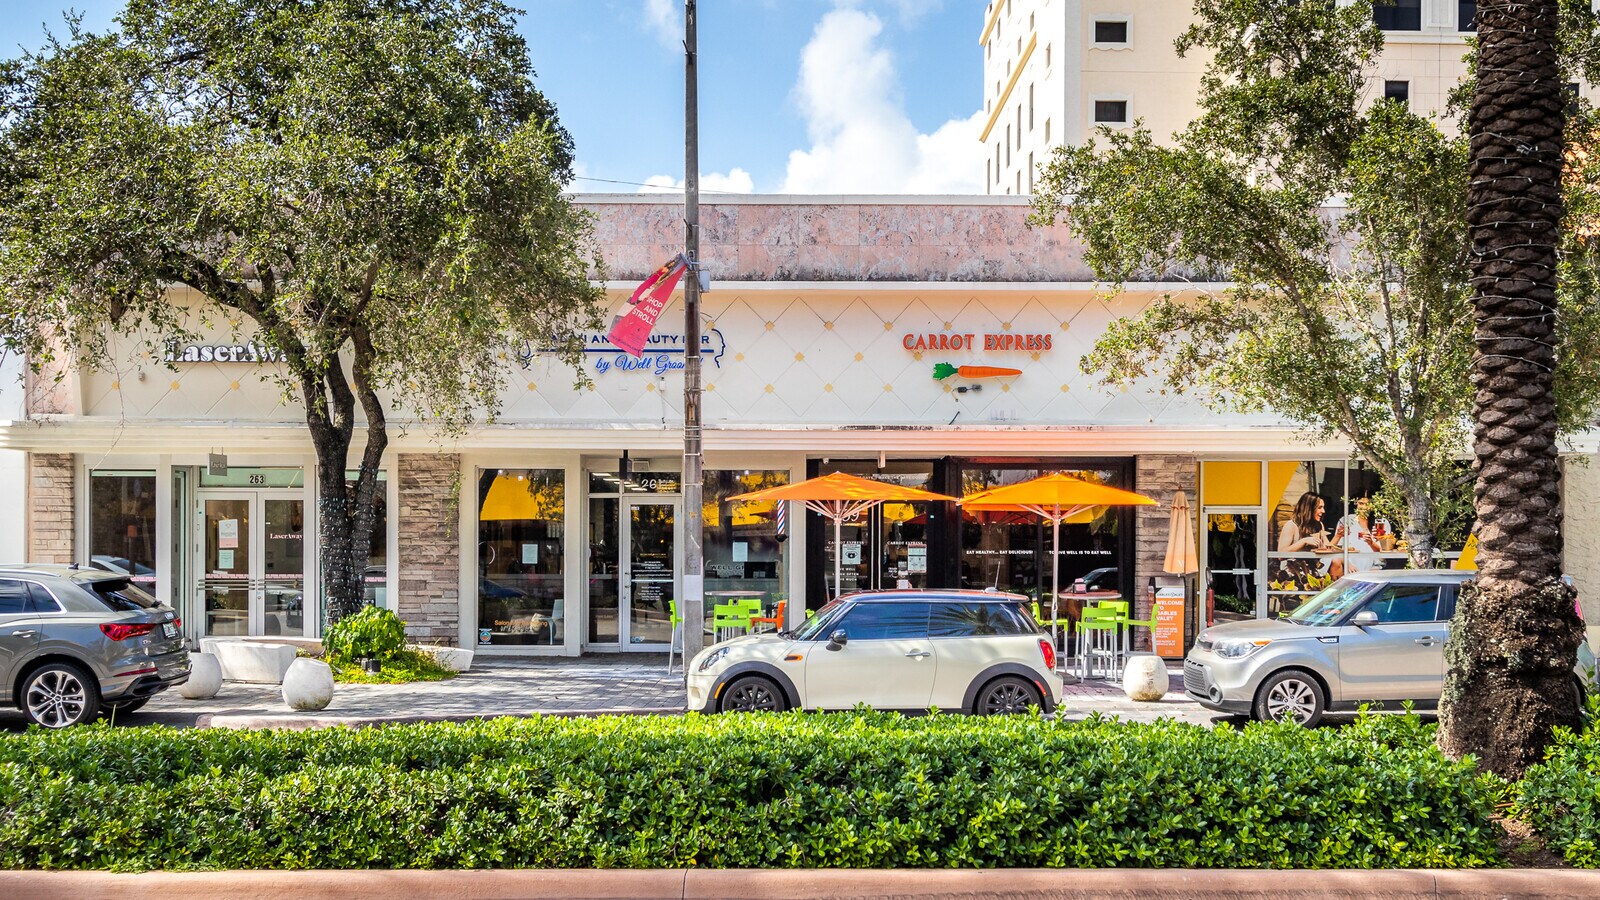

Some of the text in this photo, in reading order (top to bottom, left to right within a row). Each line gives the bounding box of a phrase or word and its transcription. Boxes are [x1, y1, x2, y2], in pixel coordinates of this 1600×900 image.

[631, 308, 653, 326] STROLL
[643, 305, 658, 317] AND
[591, 334, 610, 344] AN
[646, 334, 679, 344] AUTY
[902, 333, 1053, 351] CARROT EXPRESS
[164, 340, 308, 363] LaserAw
[595, 354, 704, 375] by Well Groo
[249, 475, 265, 484] 263
[269, 533, 303, 541] LaserAway
